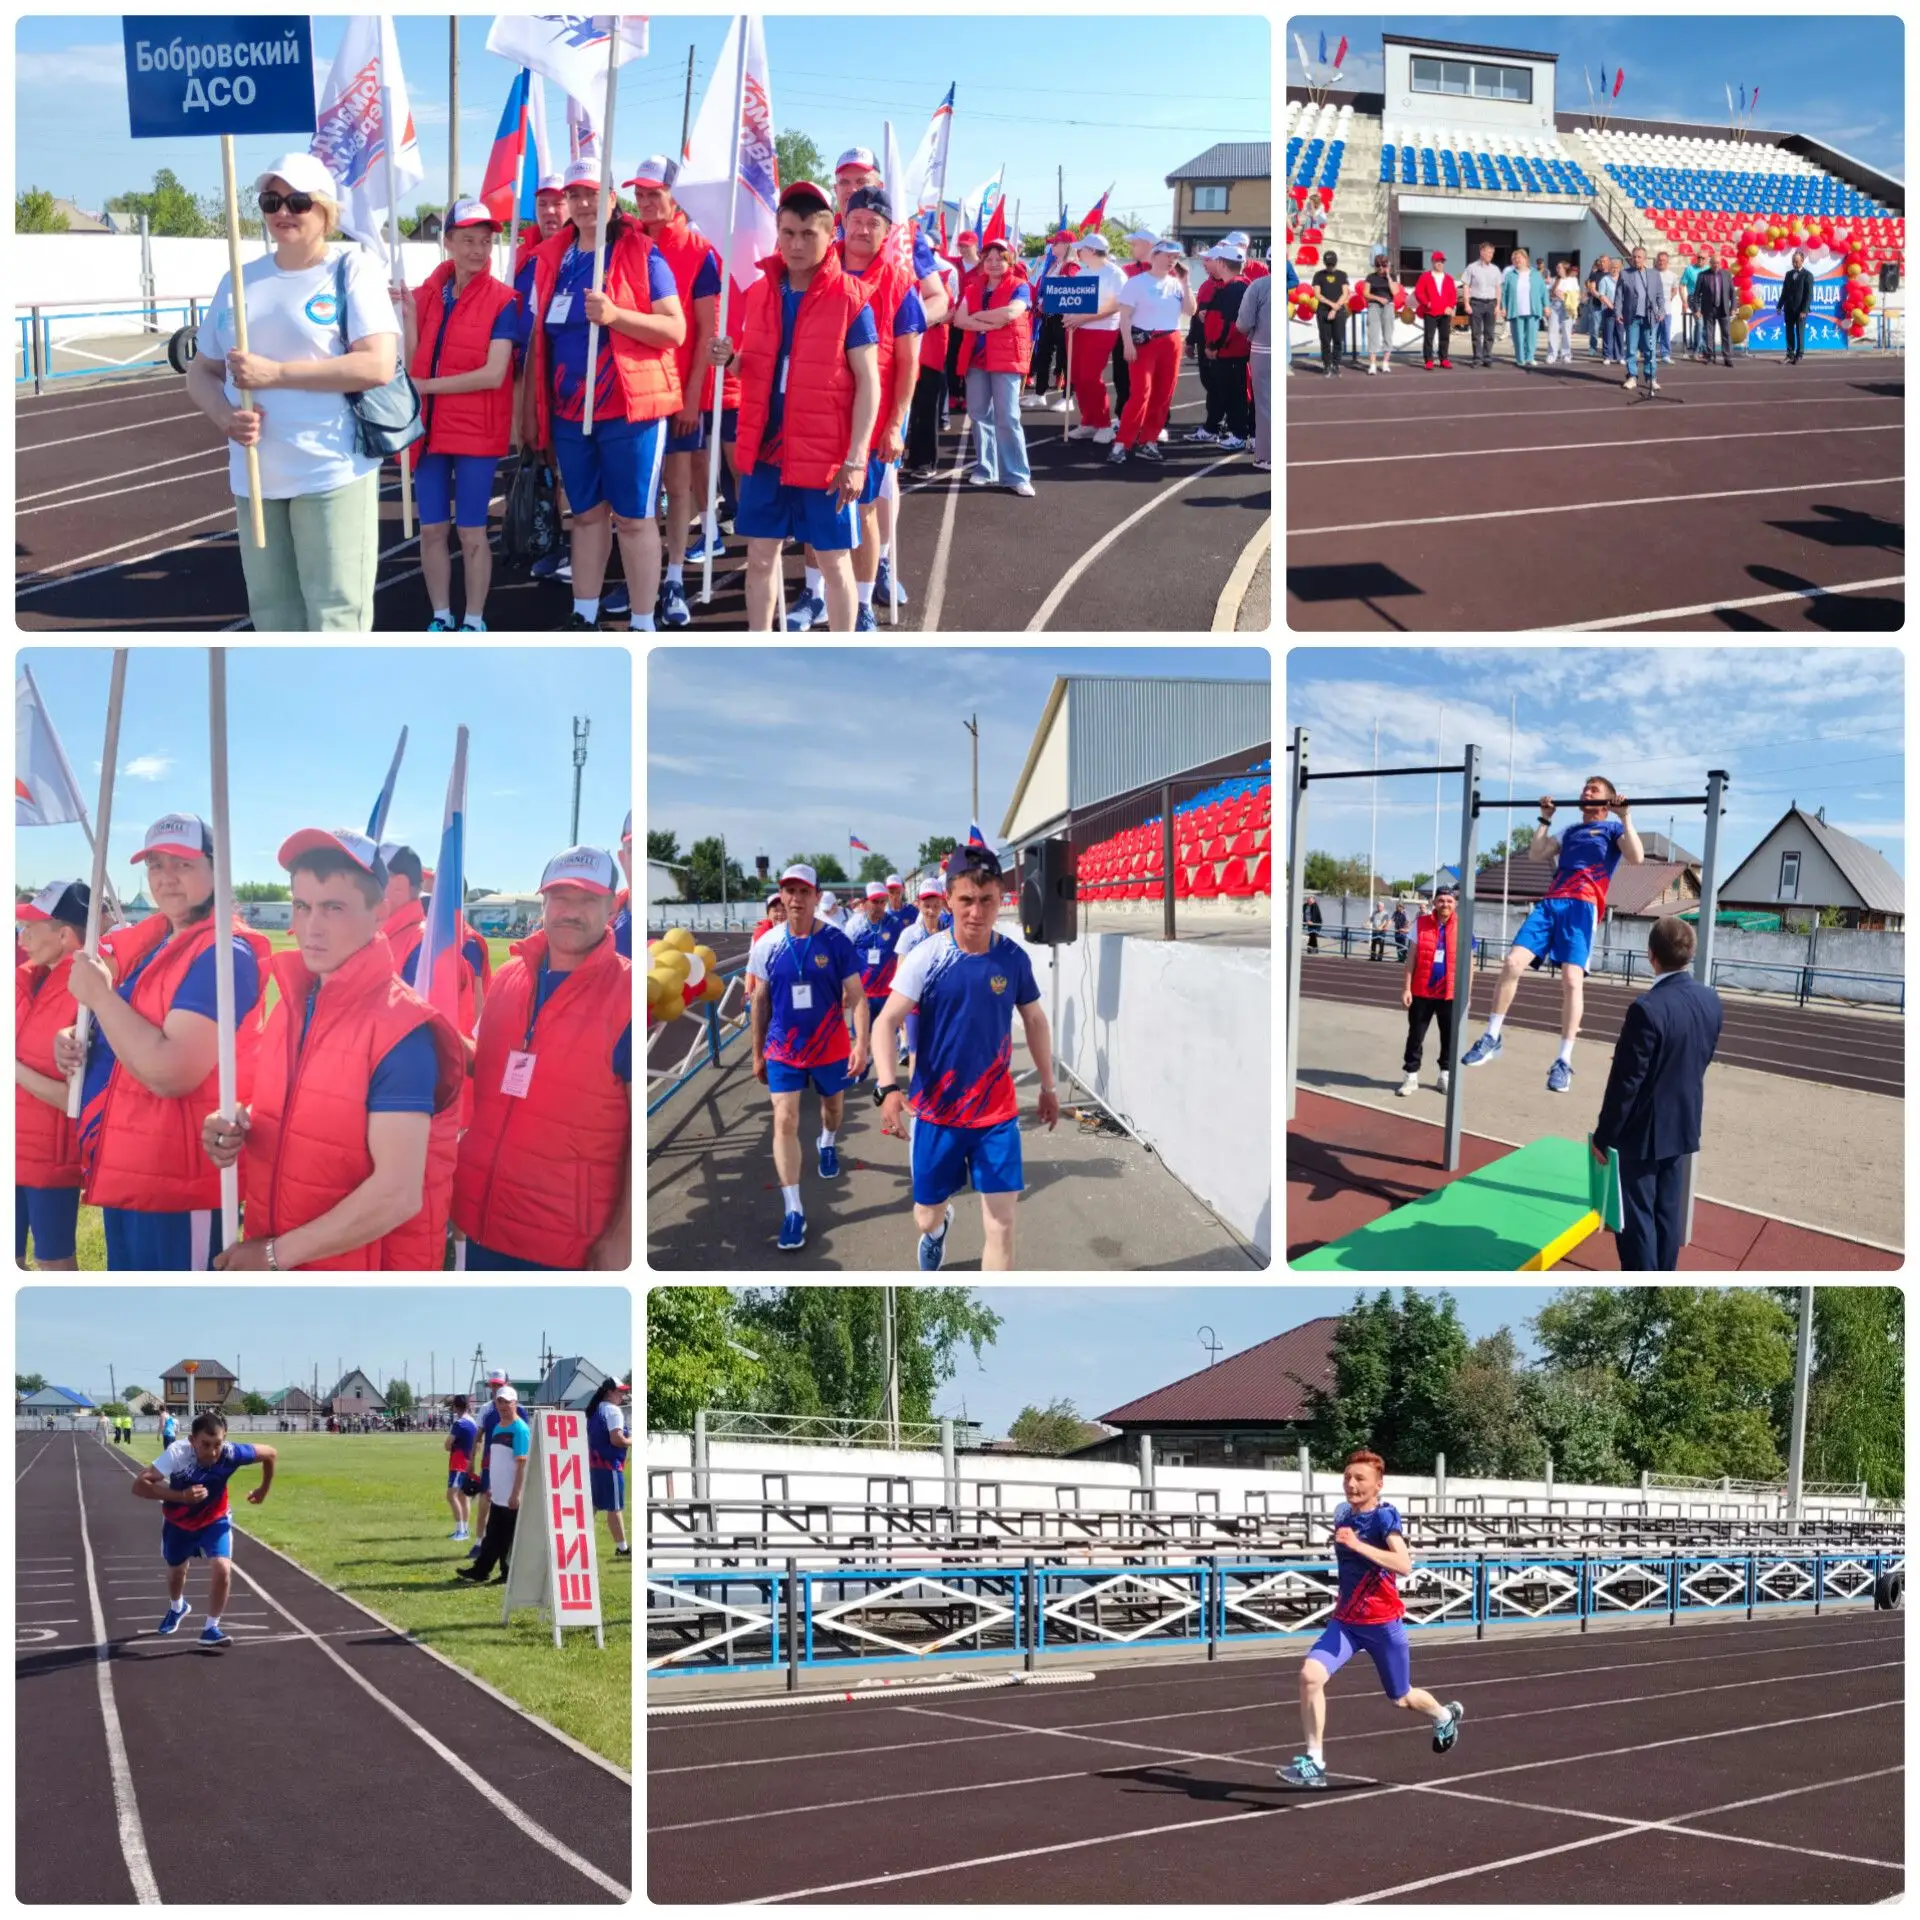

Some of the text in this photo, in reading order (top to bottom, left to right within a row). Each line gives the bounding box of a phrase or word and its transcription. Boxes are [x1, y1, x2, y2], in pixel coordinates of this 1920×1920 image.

[136, 30, 299, 77] Бобровский
[182, 75, 257, 114] ДСО
[1046, 284, 1096, 295] Масальский
[1059, 296, 1082, 307] ДСО
[547, 1415, 592, 1610] ФИНИШ
